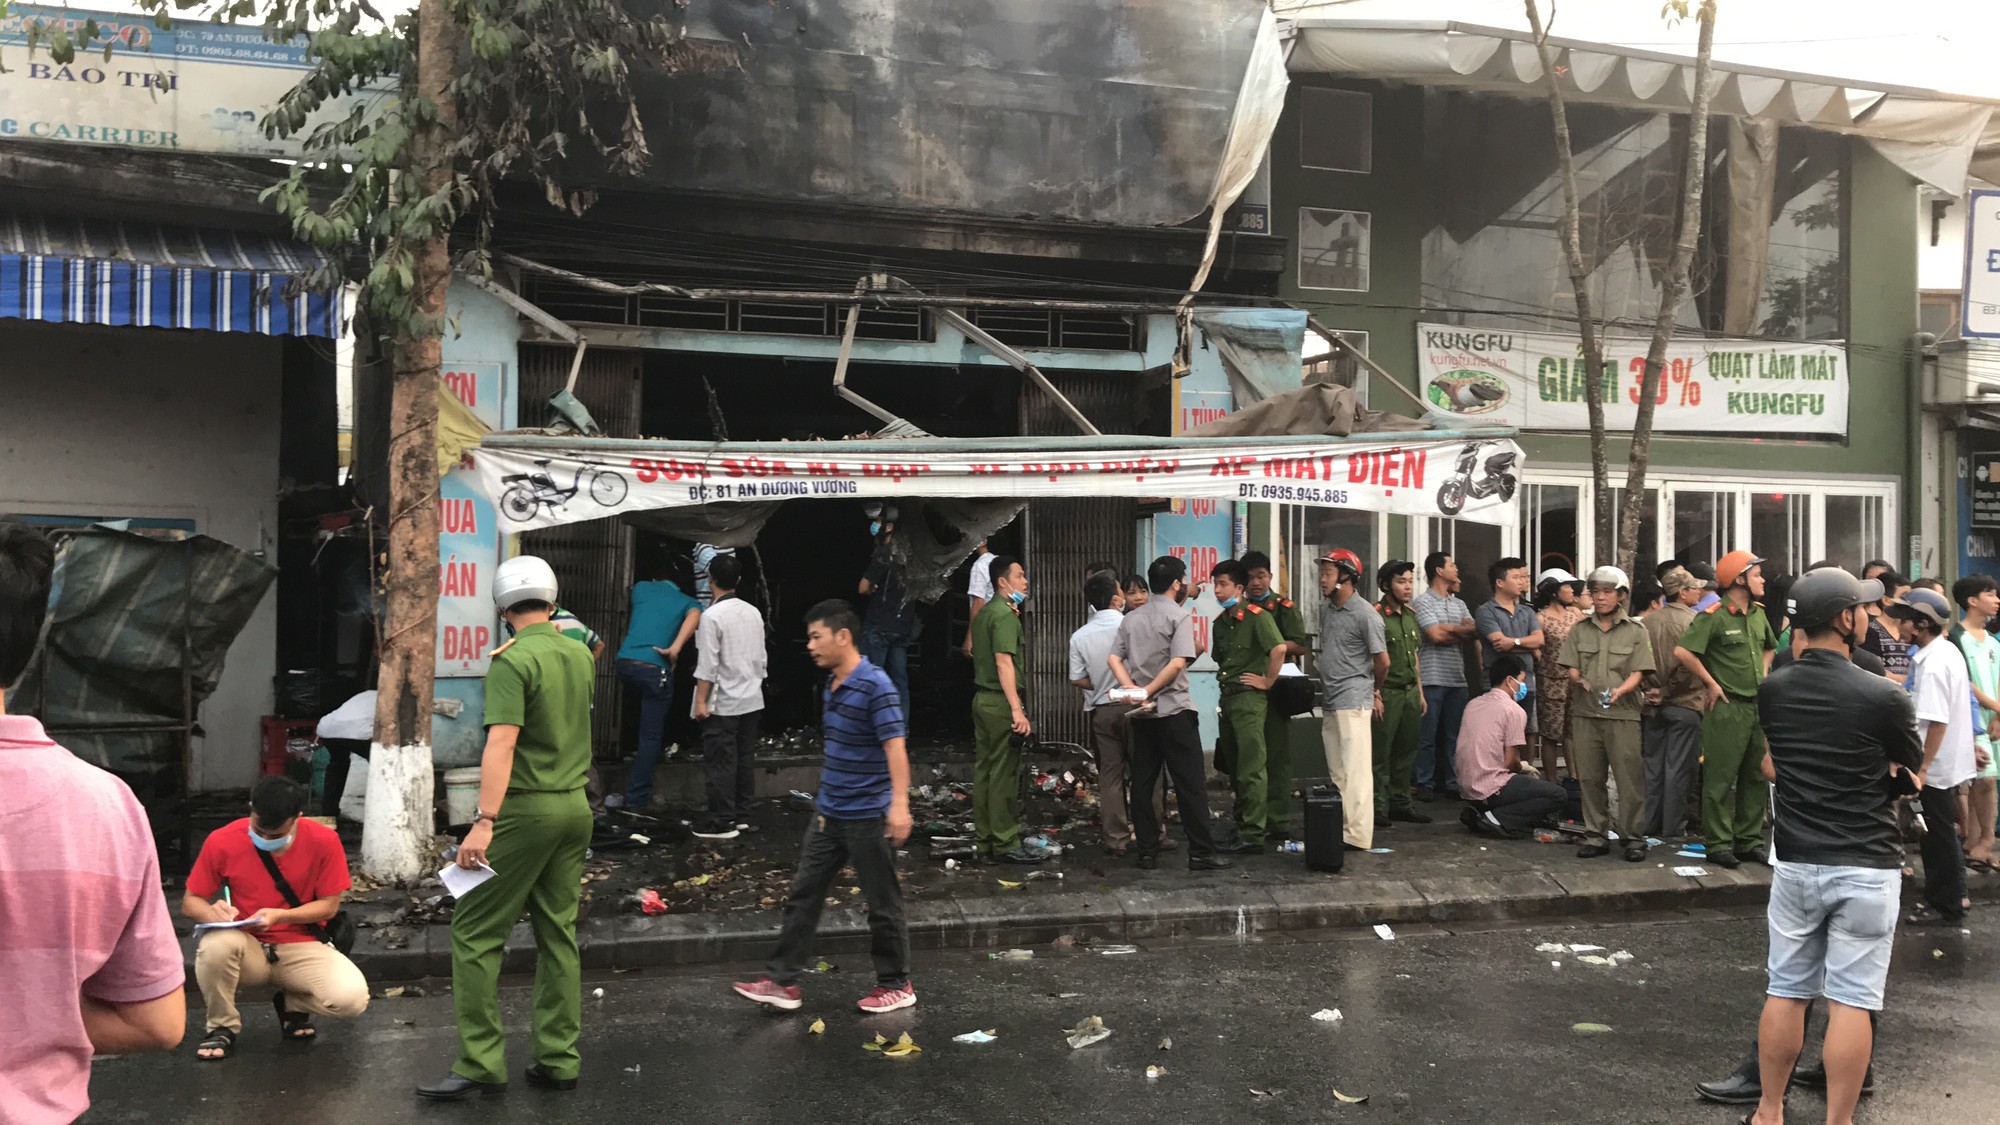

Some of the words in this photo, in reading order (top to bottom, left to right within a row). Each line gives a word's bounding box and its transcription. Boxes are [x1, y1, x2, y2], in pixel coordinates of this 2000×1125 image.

[29, 121, 180, 147] CARRIER
[1426, 331, 1513, 352] KUNGFU
[1708, 351, 1753, 384] QUẠT
[1758, 348, 1796, 380] LÀM
[1800, 350, 1838, 381] MÁT
[1727, 391, 1825, 416] KUNGFU
[1347, 446, 1428, 497] ĐIỆN
[688, 486, 713, 500] ĐC:
[716, 484, 732, 498] 81
[737, 482, 757, 497] AN
[761, 480, 808, 496] DƯƠNG
[811, 479, 857, 494] VƯƠNG
[1239, 483, 1258, 499] ĐT:
[1261, 484, 1348, 504] 0935.945.885
[443, 625, 489, 668] ĐẠP
